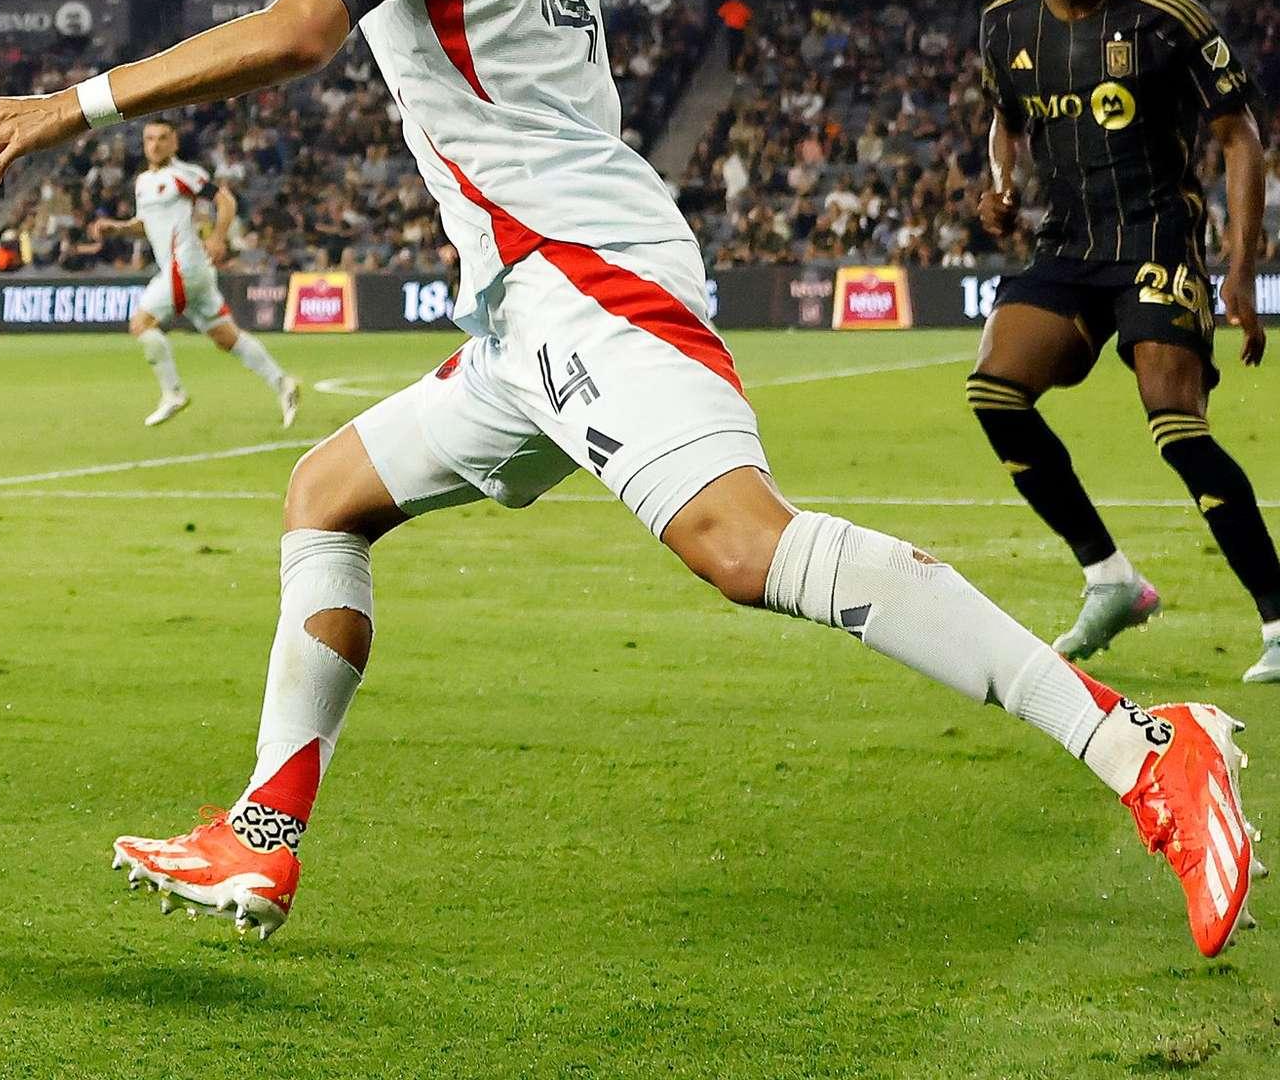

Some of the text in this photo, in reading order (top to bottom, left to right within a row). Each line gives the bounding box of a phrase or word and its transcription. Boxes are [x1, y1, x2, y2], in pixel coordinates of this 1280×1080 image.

[2, 286, 53, 323] TASTE
[401, 280, 453, 322] 18
[1135, 261, 1201, 313] 26
[536, 341, 601, 416] 4
